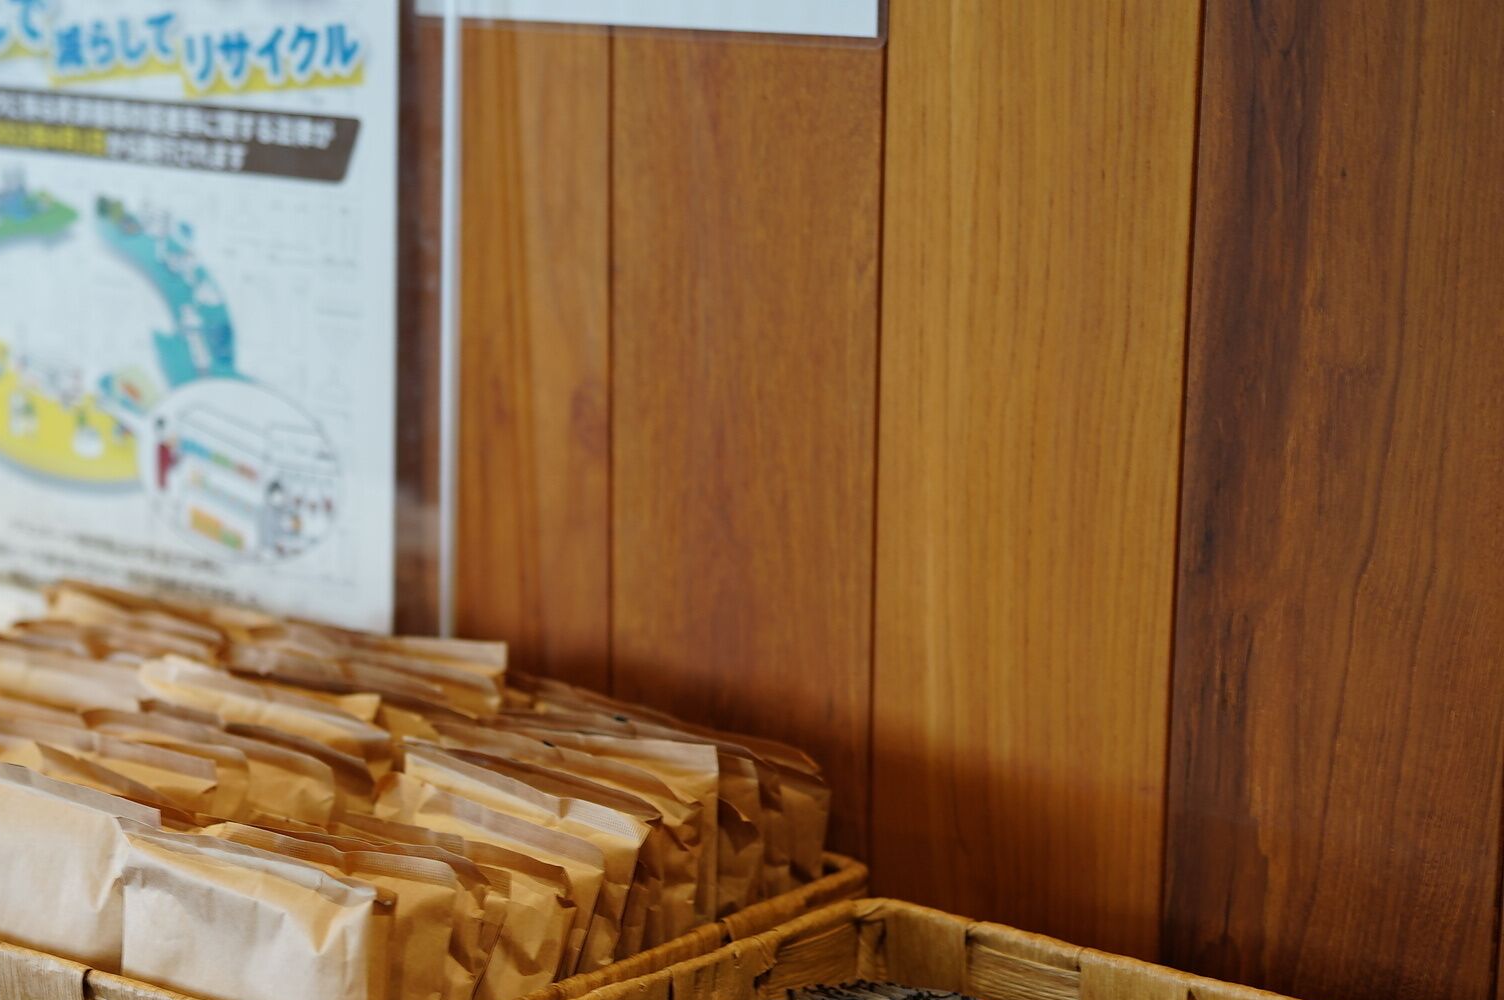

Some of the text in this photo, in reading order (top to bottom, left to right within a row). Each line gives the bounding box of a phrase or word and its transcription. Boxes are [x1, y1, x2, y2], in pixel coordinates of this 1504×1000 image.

[183, 22, 360, 81] リサイクル
